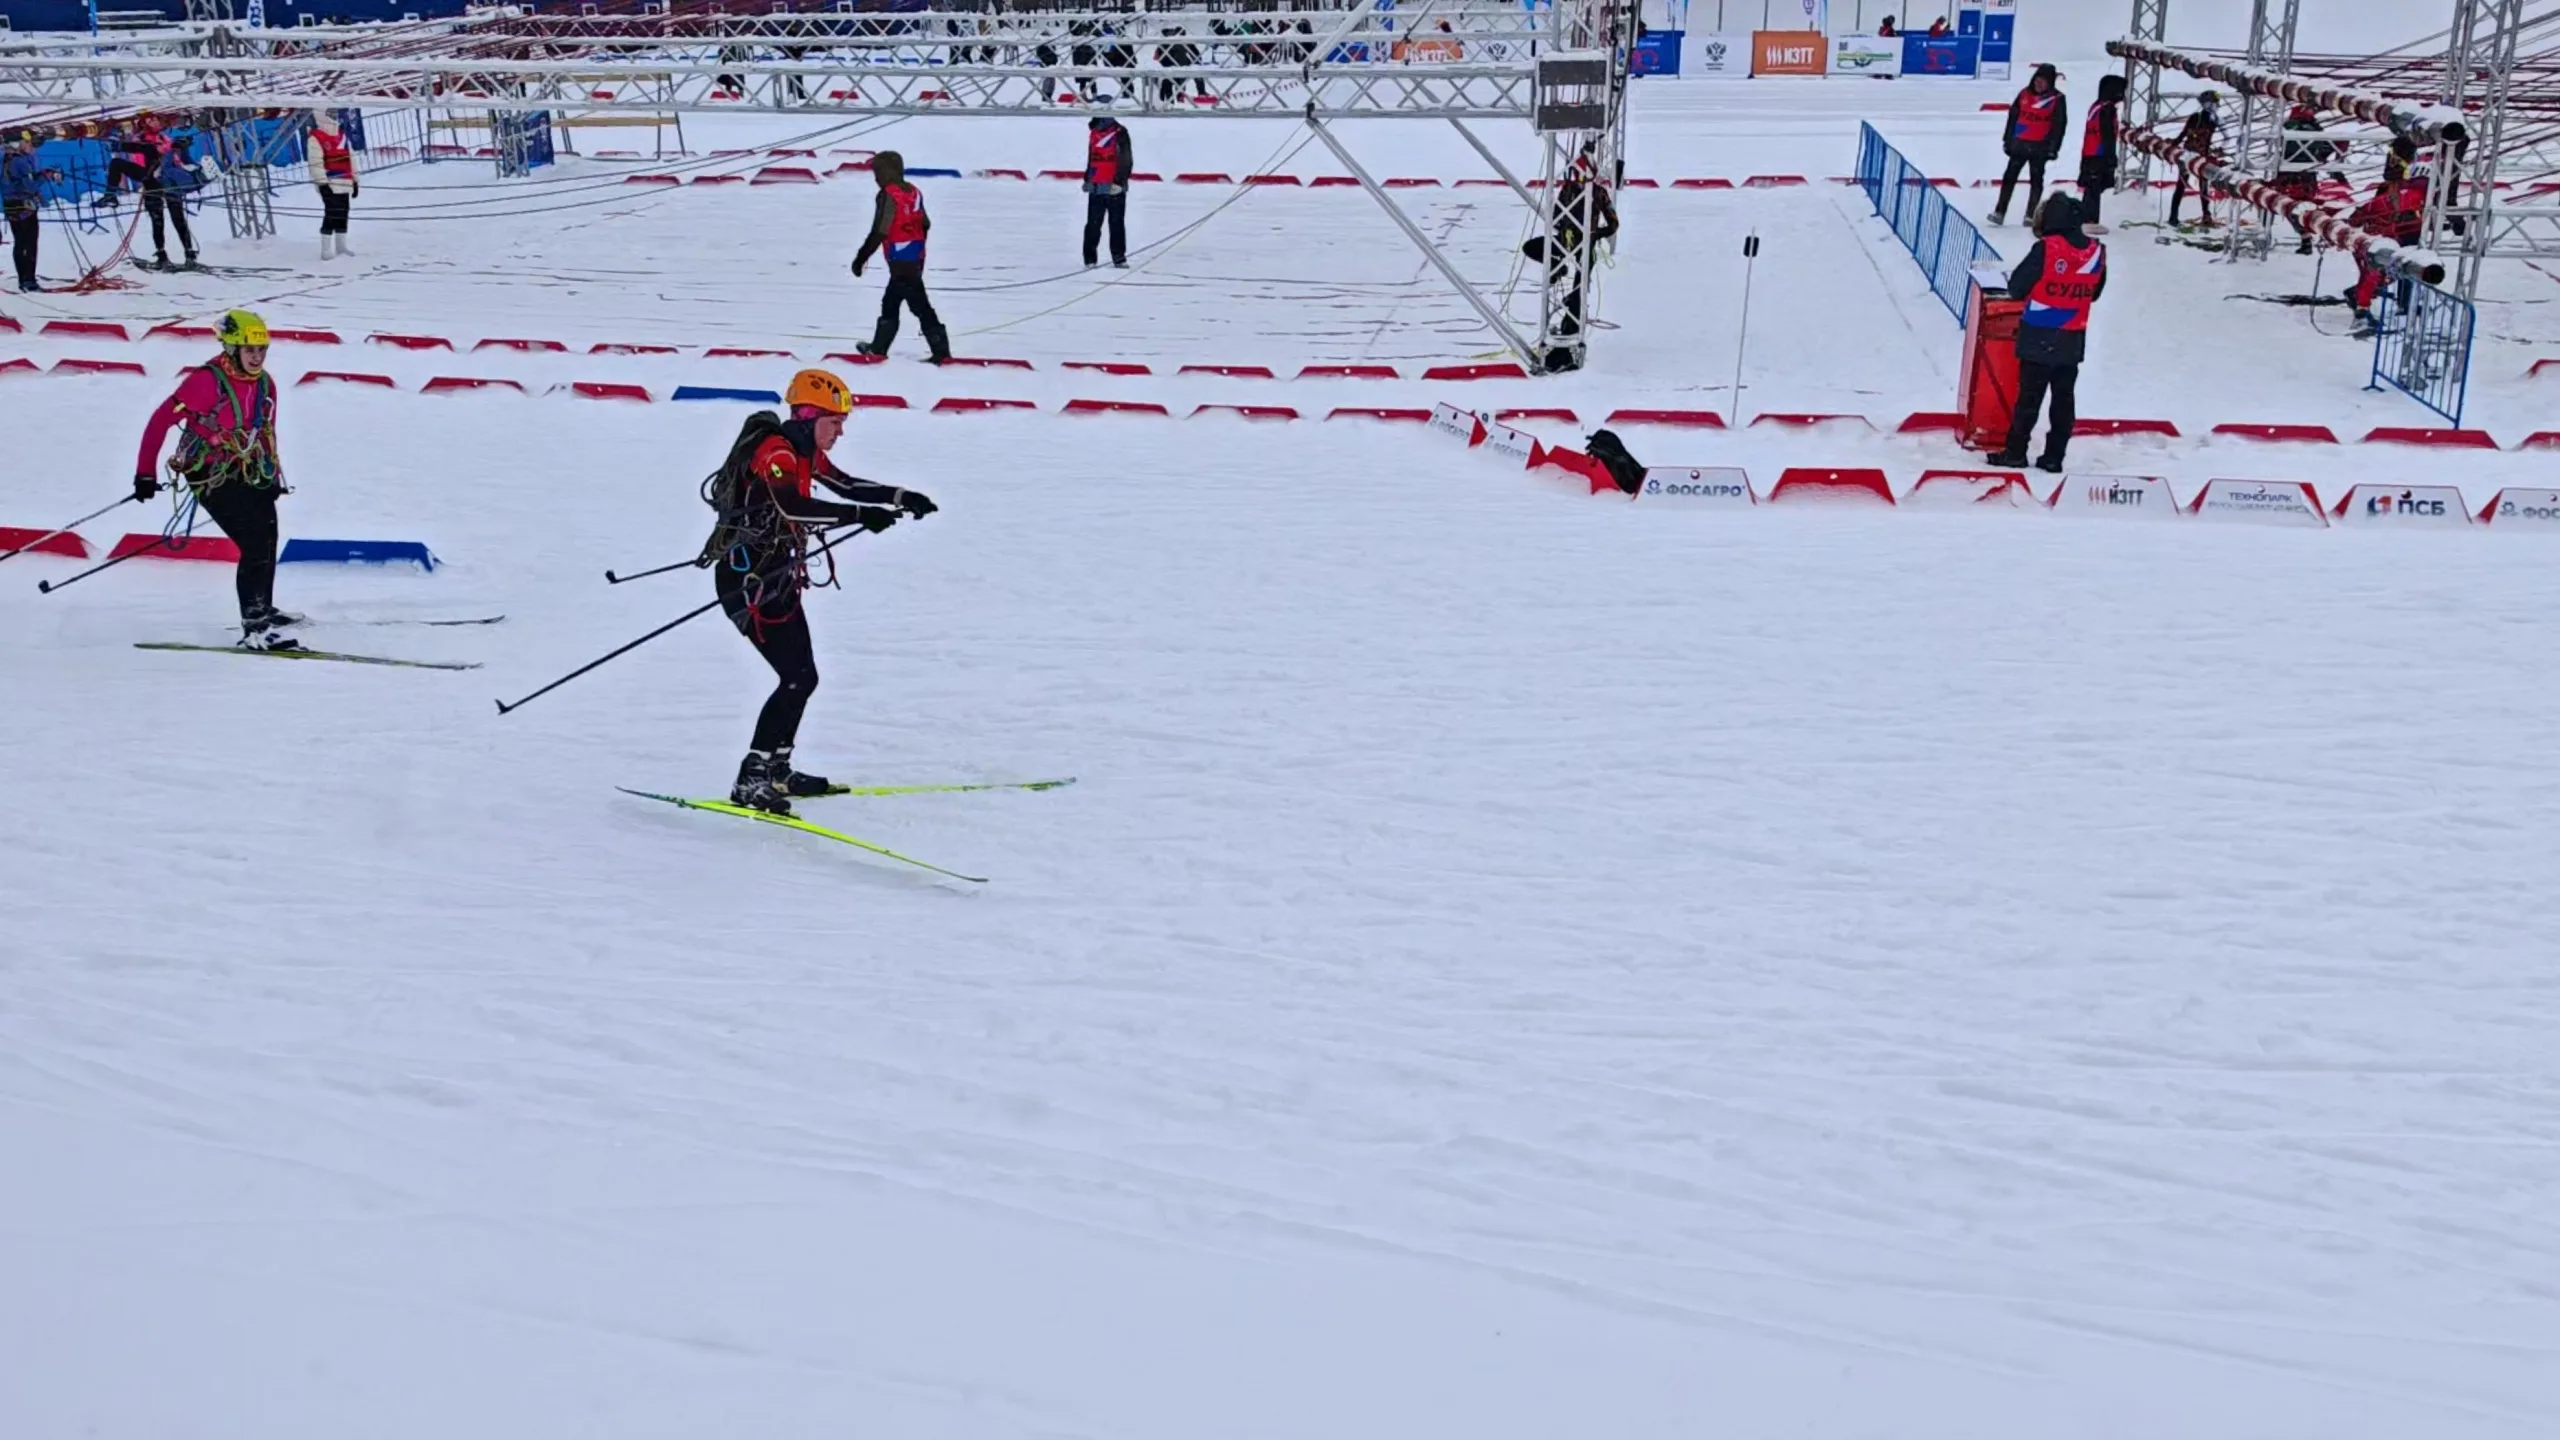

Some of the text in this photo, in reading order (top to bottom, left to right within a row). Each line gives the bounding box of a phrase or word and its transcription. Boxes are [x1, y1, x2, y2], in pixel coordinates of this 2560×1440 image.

[2045, 282, 2096, 299] СУДЬ
[1666, 484, 1742, 497] ФОСАГРО
[2229, 492, 2293, 503] ТЕХНОПАРК
[2398, 499, 2446, 516] ПСБ
[2522, 506, 2560, 520] ФОС
